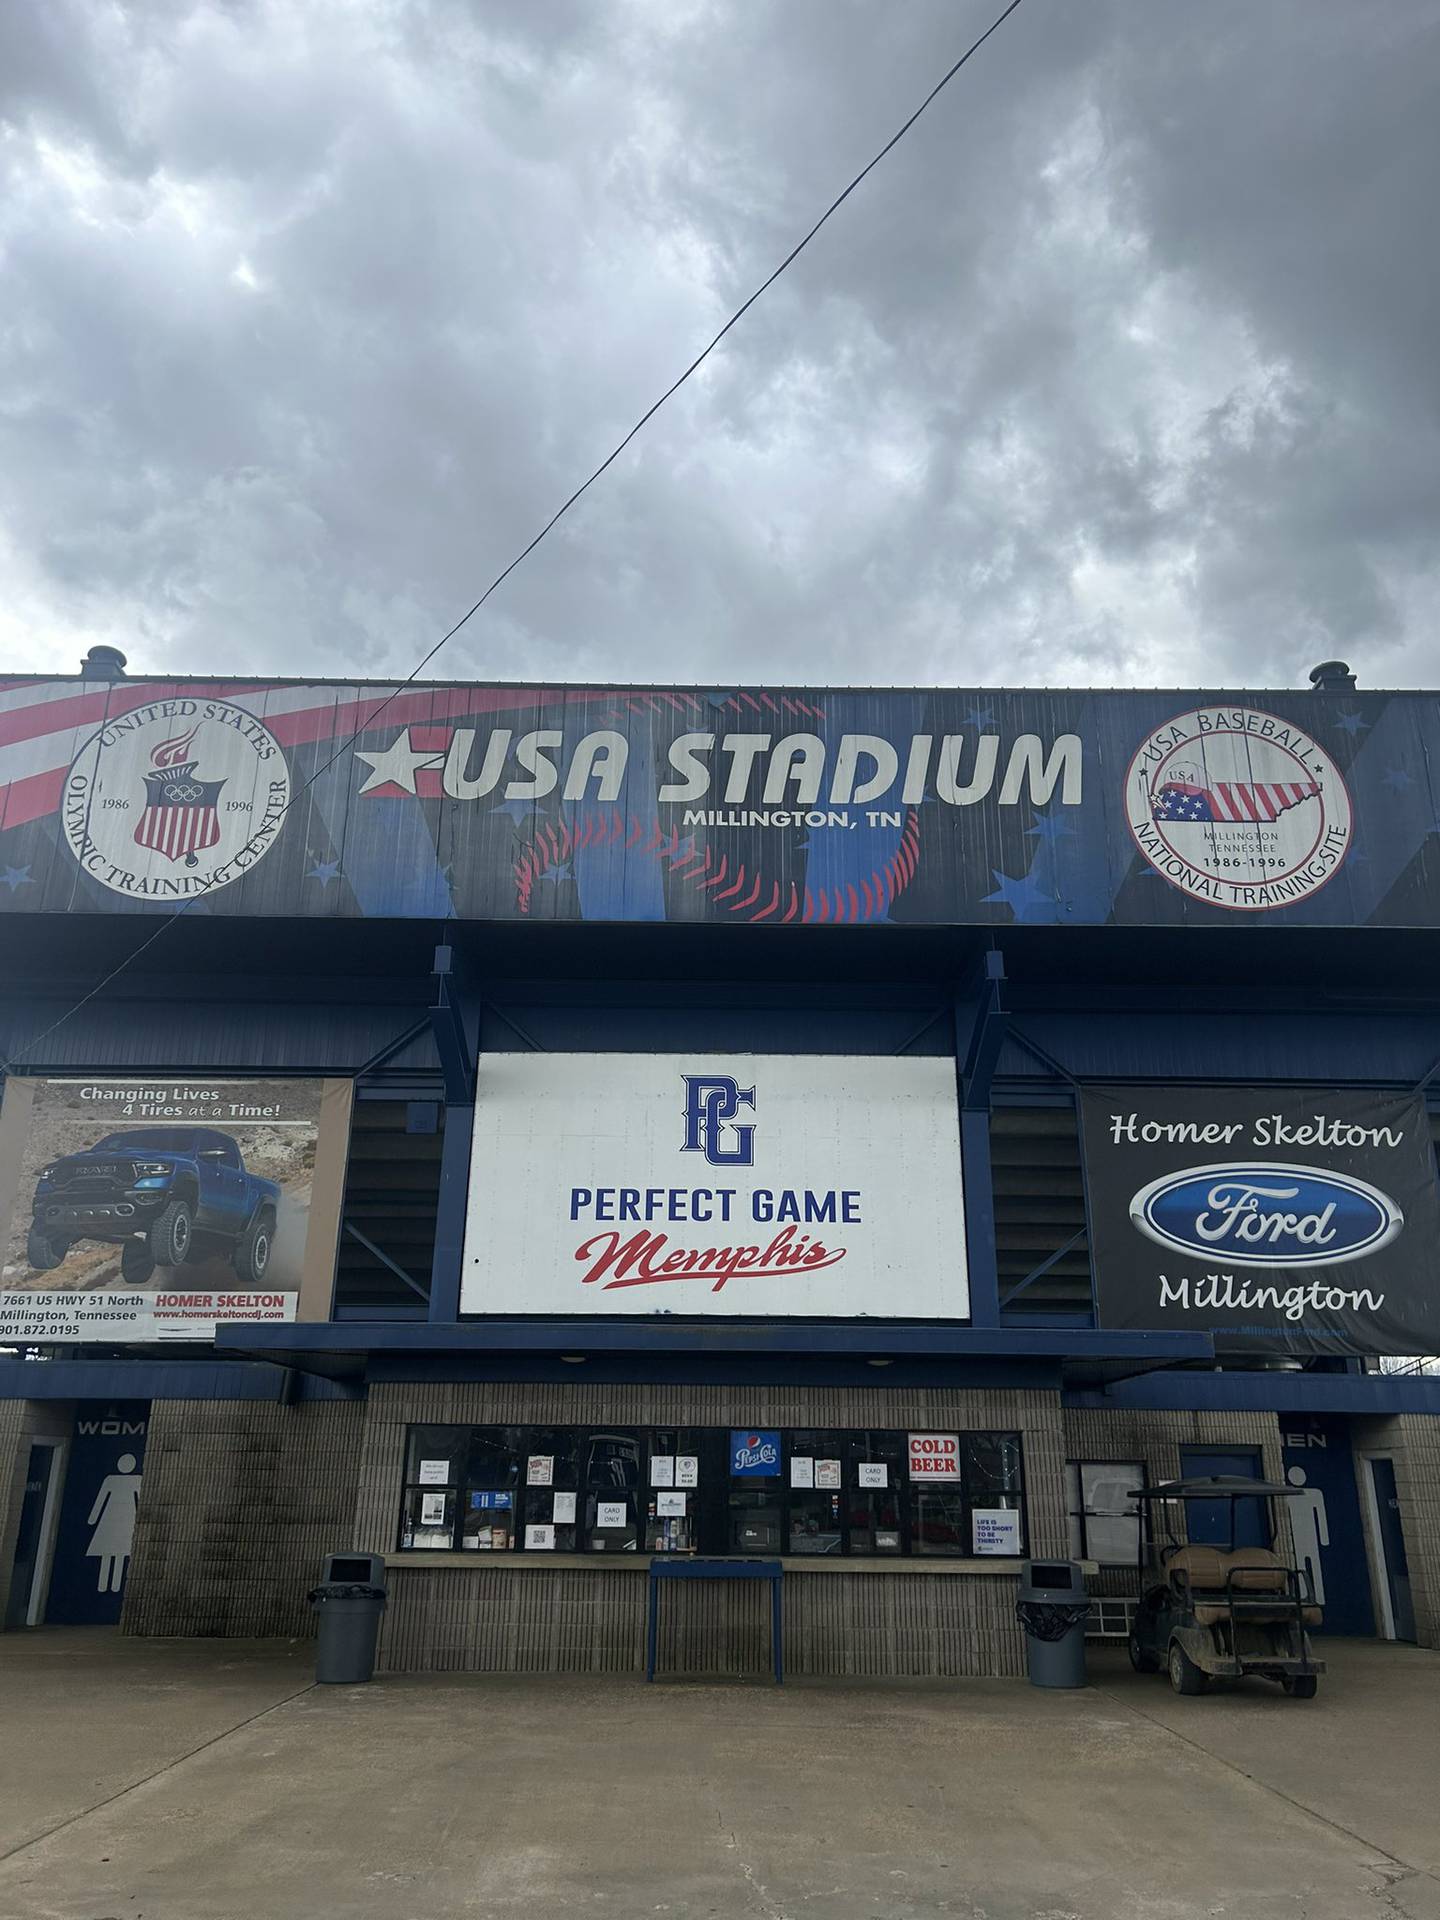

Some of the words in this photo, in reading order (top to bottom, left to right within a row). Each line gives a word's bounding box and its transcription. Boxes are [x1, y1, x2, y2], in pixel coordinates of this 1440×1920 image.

[97, 700, 197, 748] UNITED
[203, 703, 276, 760] STATES
[1143, 725, 1188, 762] USA
[1197, 711, 1314, 765] BASEBALL
[442, 728, 631, 801] USA
[659, 733, 1084, 806] STADIUM
[1169, 770, 1195, 783] USA
[102, 798, 130, 810] 1986
[225, 801, 254, 812] 1996
[682, 810, 858, 829] MILLINGTON,
[866, 811, 901, 827] TN
[67, 775, 106, 871] OLYMPIC
[104, 864, 231, 896] TRAINING
[234, 778, 288, 869] CENTER
[1204, 832, 1279, 841] MILLINGTON
[1208, 844, 1276, 853] TENNESSEE
[1134, 821, 1223, 900] NATIONAL
[1229, 860, 1327, 904] TRAINING
[1319, 825, 1347, 865] SITE
[1204, 857, 1286, 868] 1986-1996
[80, 1087, 167, 1103] Changing
[173, 1087, 219, 1100] Lives
[122, 1104, 133, 1116] 4
[140, 1104, 183, 1116] Tires
[189, 1106, 205, 1117] at
[212, 1107, 222, 1117] a
[229, 1104, 281, 1117] Time!
[1110, 1112, 1243, 1144] Homer
[1252, 1114, 1403, 1148] Skelton
[569, 1187, 737, 1222] PERFECT
[751, 1189, 862, 1224] GAME
[1195, 1183, 1337, 1244] Ford
[574, 1224, 847, 1292] Memphis
[3, 1295, 32, 1306] 7661
[36, 1295, 53, 1306] US
[56, 1295, 86, 1306] HWY
[89, 1295, 104, 1306] 51
[107, 1295, 144, 1306] North
[156, 1294, 213, 1307] HOMER
[217, 1294, 285, 1308] SKELTON
[1159, 1274, 1384, 1320] Millington
[0, 1310, 70, 1323] Millington,
[74, 1310, 137, 1320] Tennessee
[153, 1310, 285, 1320] www.homerskeltoncdj.com
[0, 1325, 80, 1335] 901.872.0195
[910, 1439, 956, 1454] COLD
[1280, 1433, 1327, 1448] EN
[910, 1457, 957, 1472] BEER
